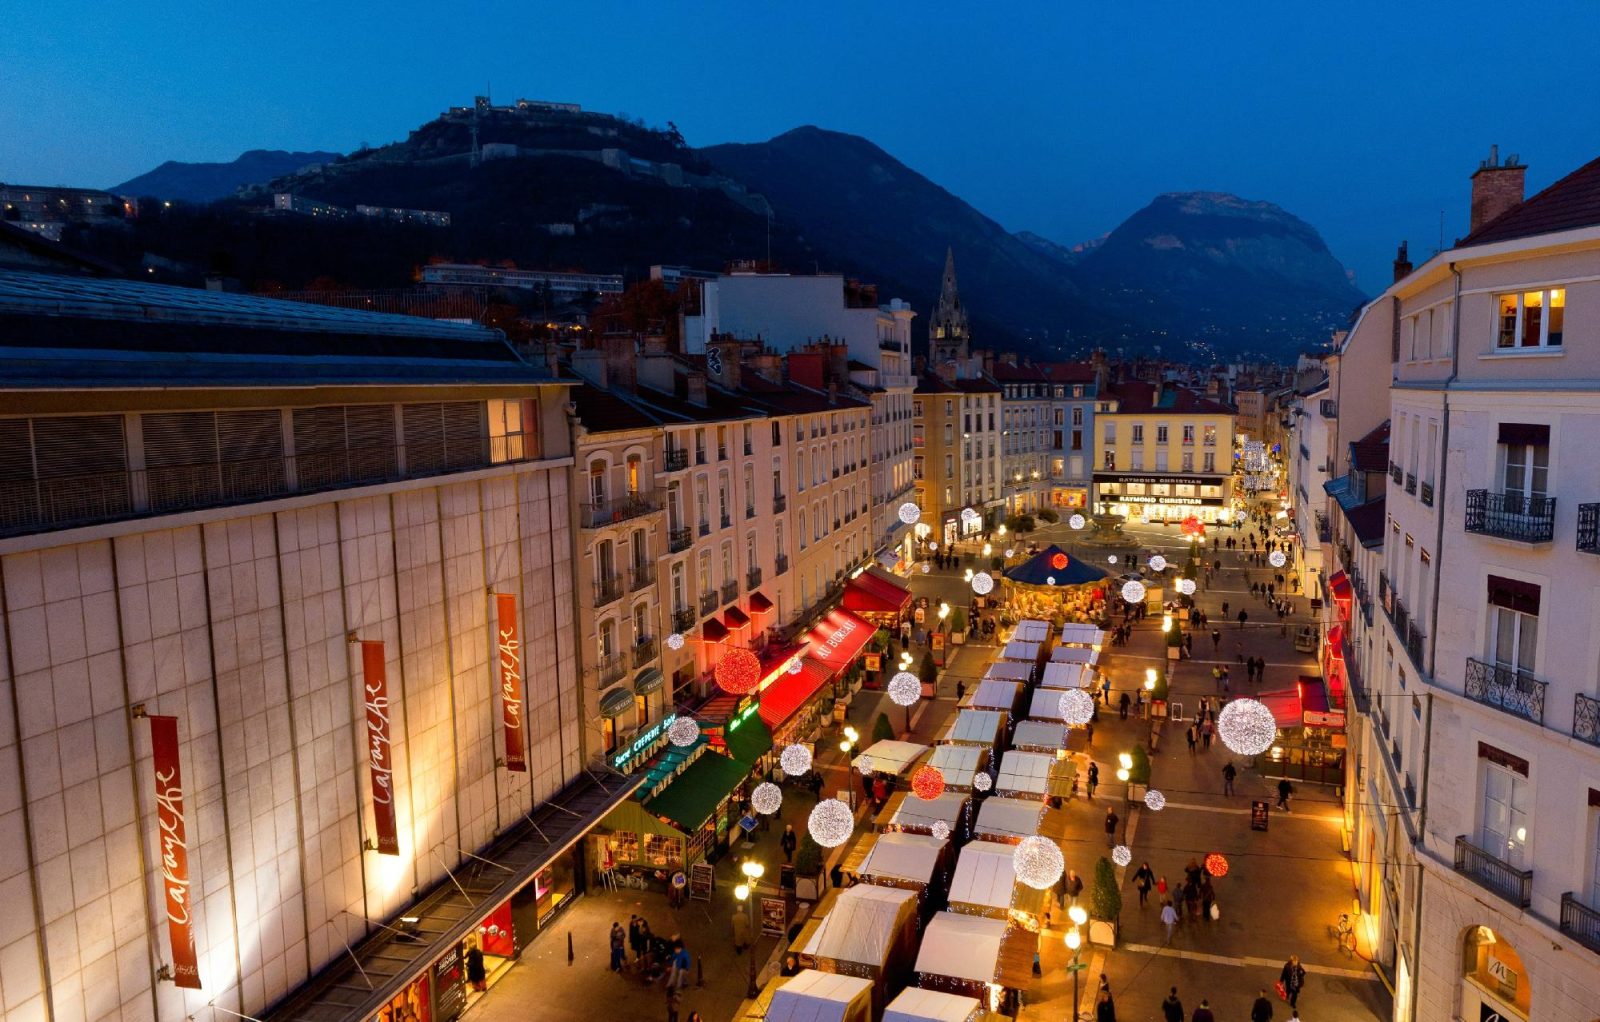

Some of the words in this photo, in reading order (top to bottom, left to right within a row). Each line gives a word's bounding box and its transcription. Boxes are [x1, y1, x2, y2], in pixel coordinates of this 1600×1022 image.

[1119, 496, 1157, 504] RAYMOND
[815, 644, 832, 660] AU
[826, 619, 857, 649] BUREAU
